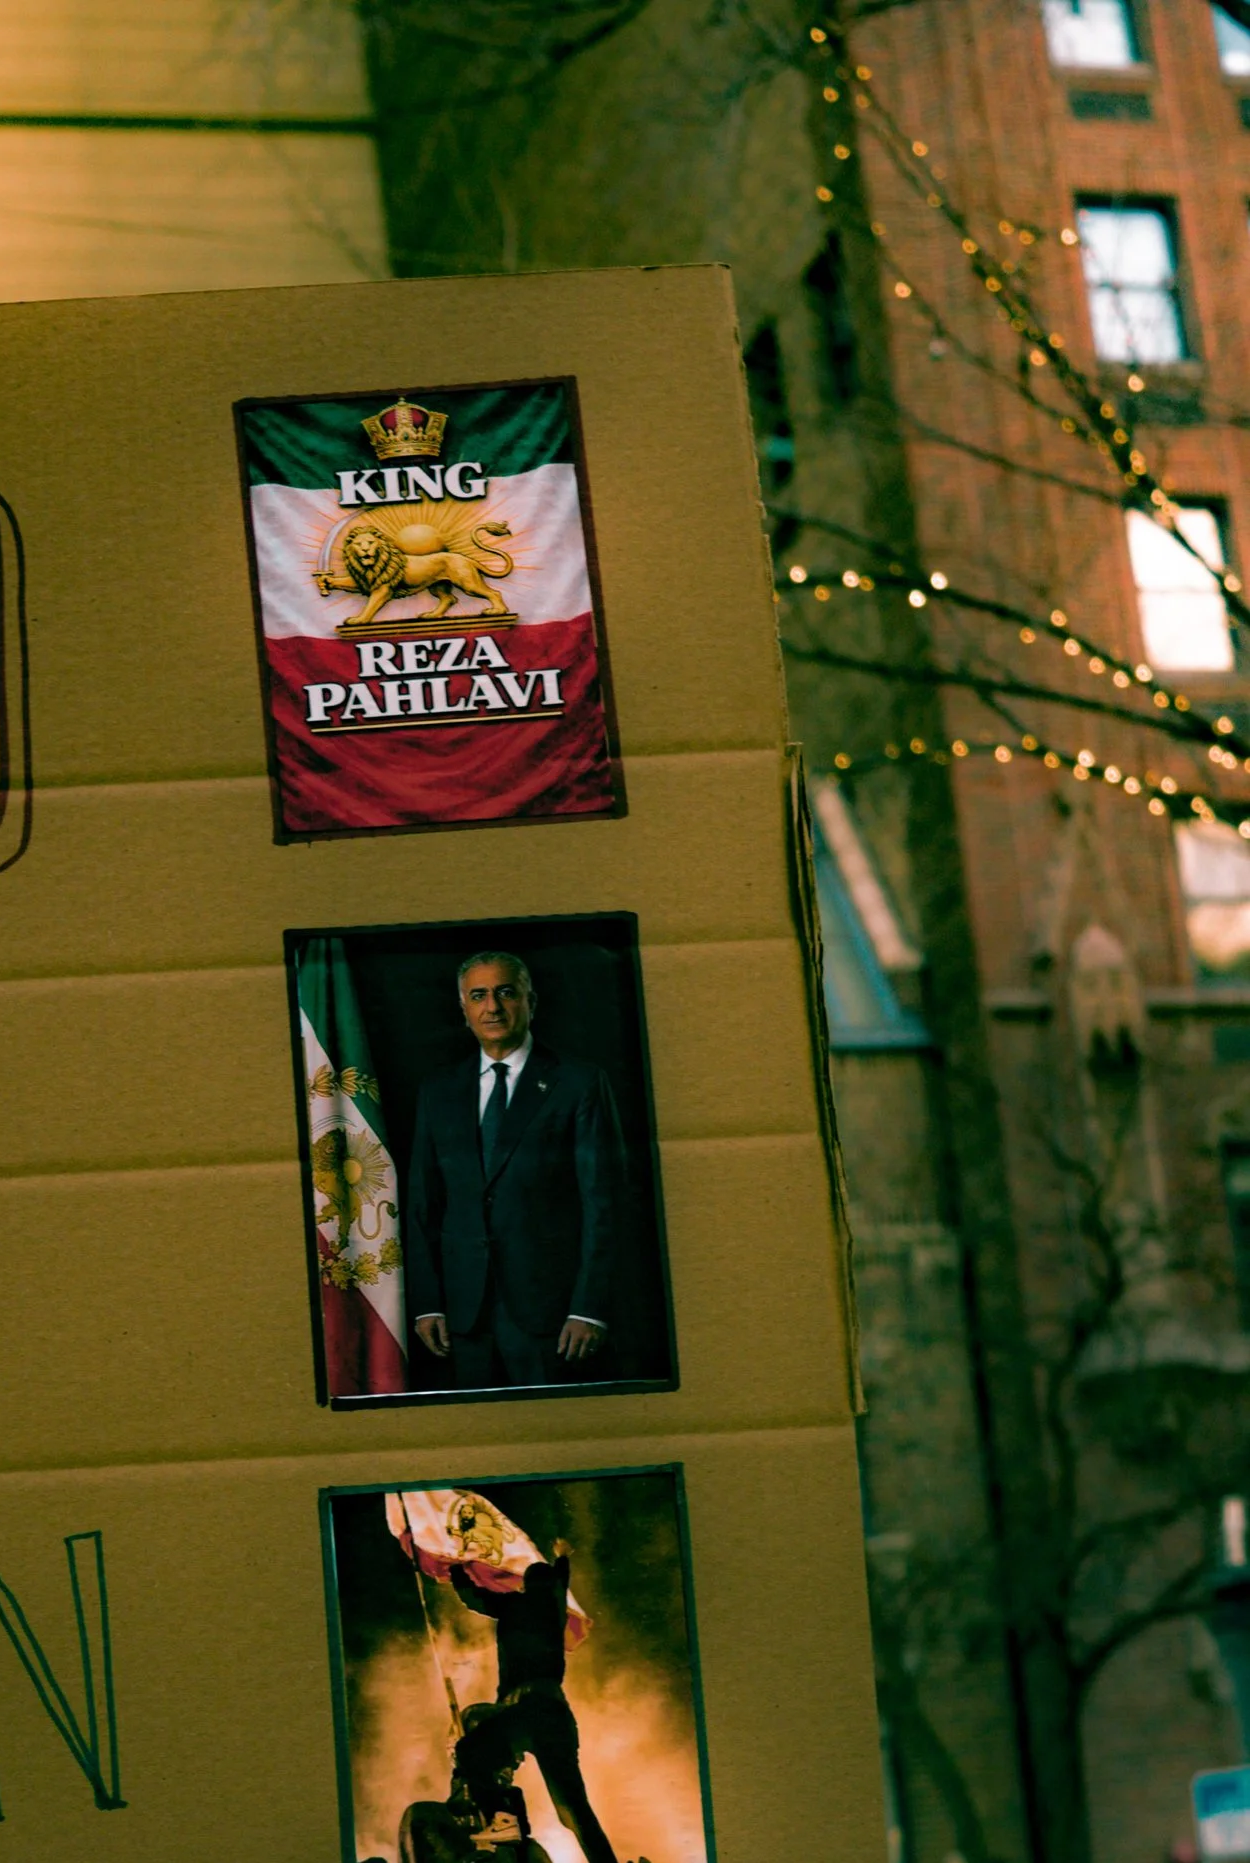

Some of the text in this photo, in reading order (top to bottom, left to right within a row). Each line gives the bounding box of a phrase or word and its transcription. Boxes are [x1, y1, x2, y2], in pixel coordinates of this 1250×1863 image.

[336, 461, 489, 507] KING
[355, 636, 509, 678] REZA
[304, 669, 564, 724] PAHLAVI
